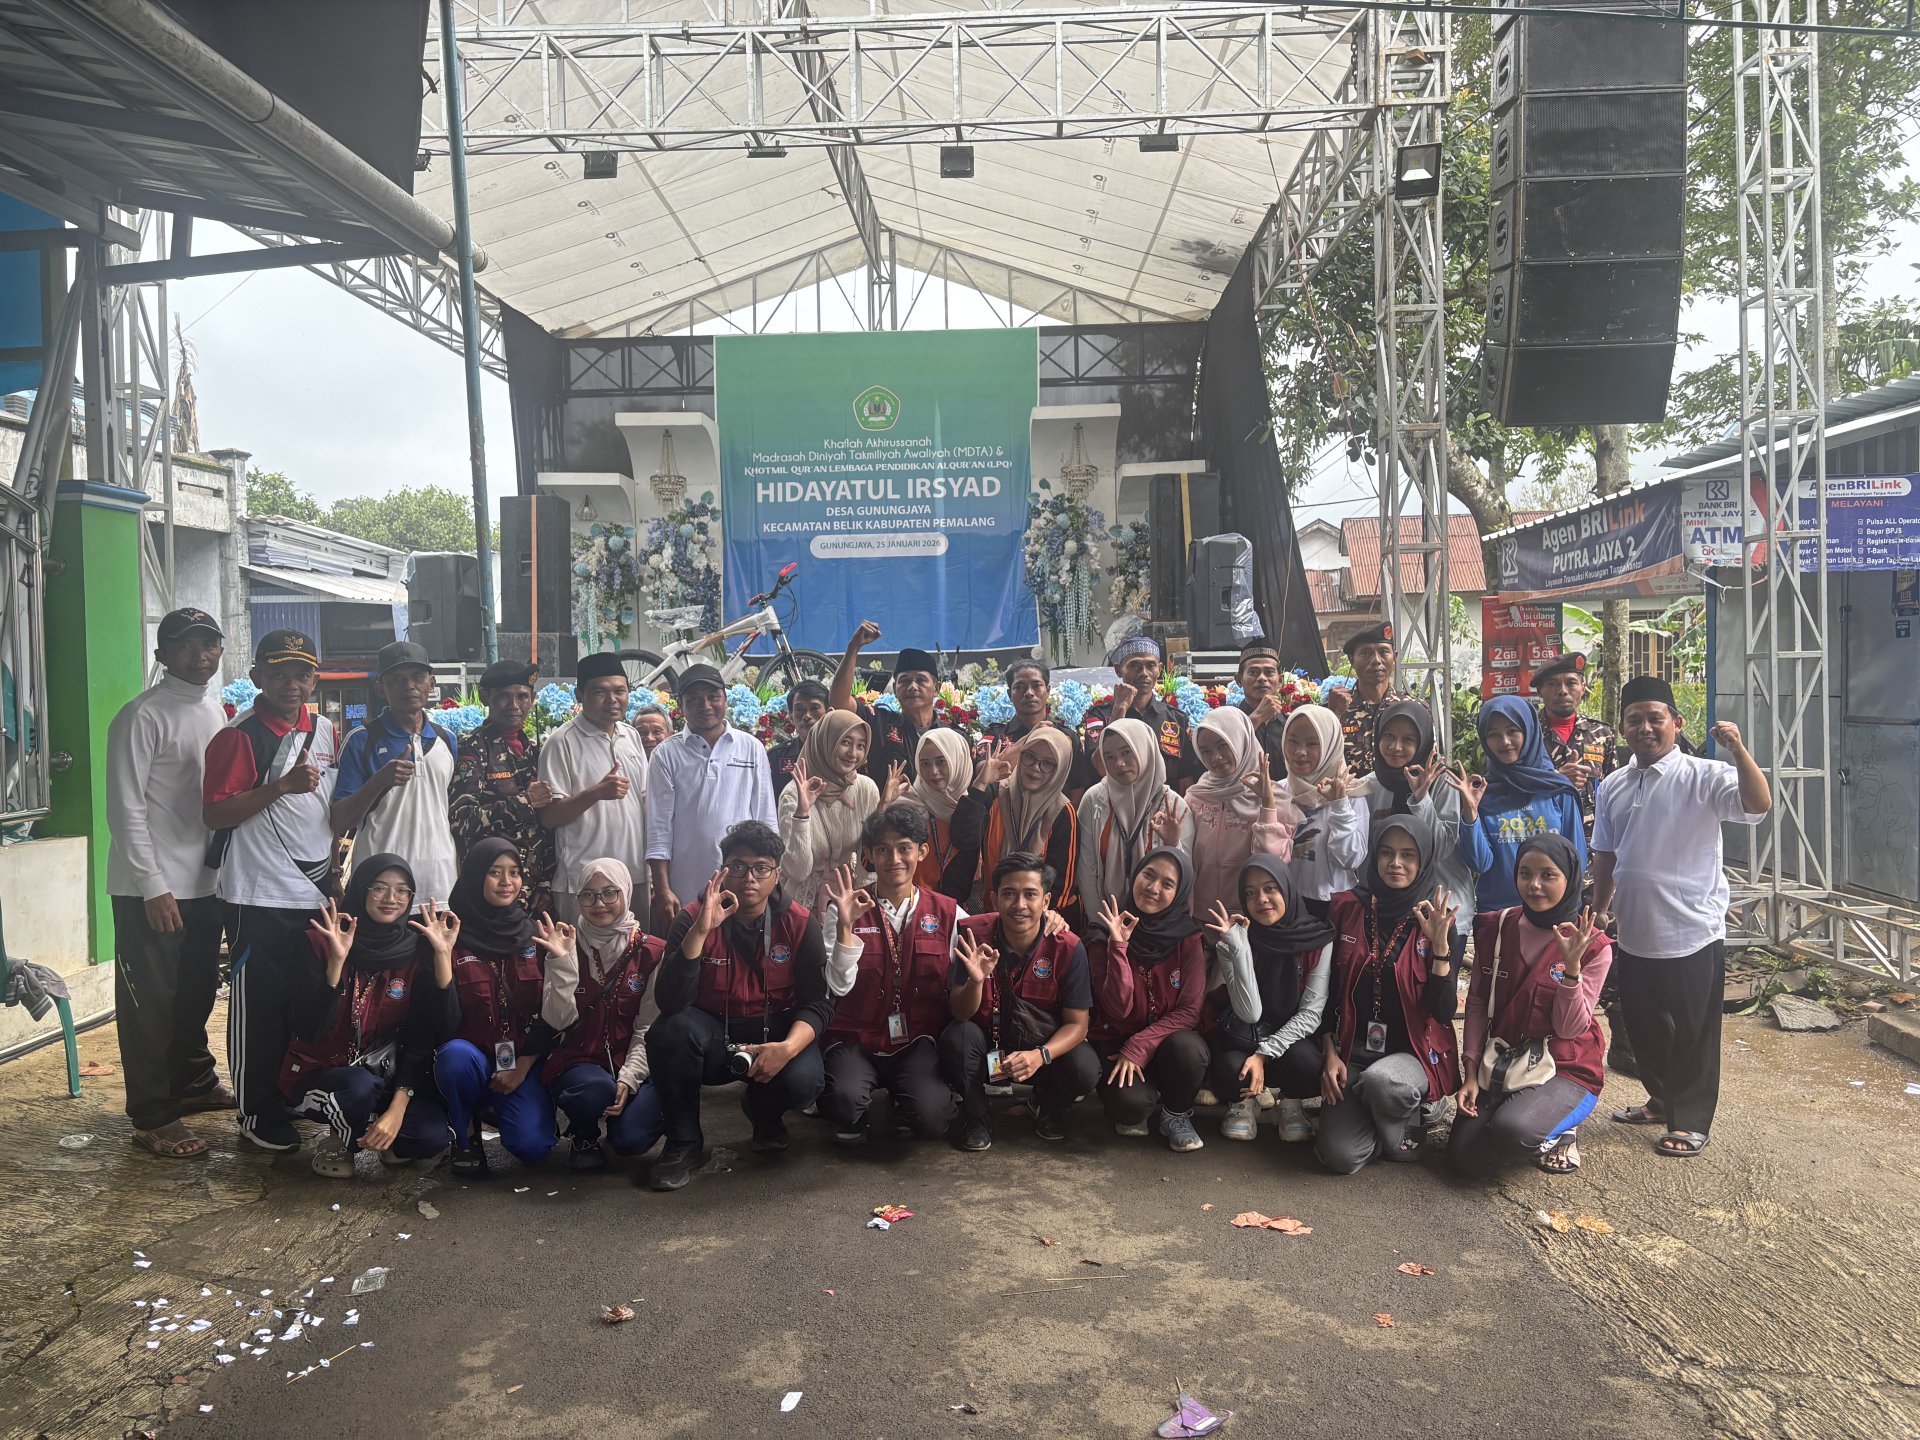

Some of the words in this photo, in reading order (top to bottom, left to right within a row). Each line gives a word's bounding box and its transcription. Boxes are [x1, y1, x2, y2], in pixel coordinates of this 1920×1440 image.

[824, 438, 863, 449] Khaflah
[866, 436, 932, 448] Akhirussanah
[753, 452, 806, 463] Madrasah
[809, 450, 847, 462] Diniyah
[850, 448, 901, 461] Takmiliyah
[904, 447, 951, 460] Awaliyah
[953, 446, 993, 458] (MDTA)
[996, 446, 1004, 457] &
[744, 466, 789, 477] KHOTMIL
[829, 464, 873, 473] LEMBAGA
[876, 462, 935, 471] PENDIDIKAN
[986, 460, 1013, 469] (LPQ)
[757, 479, 901, 503] HIDAYATUL
[907, 476, 1002, 499] IRSYAD
[826, 506, 854, 516] DESA
[856, 504, 932, 515] GUNUNGJAYA
[1831, 500, 1884, 508] MELAYANI
[763, 521, 831, 533] KECAMATAN
[833, 520, 863, 531] BELIK
[865, 518, 930, 530] KABUPATEN
[933, 517, 995, 528] PEMALANG
[1542, 523, 1577, 553] Agen
[1580, 498, 1646, 539] BRILink
[1690, 526, 1743, 545] ATM
[1867, 528, 1885, 536] Bayar
[820, 541, 875, 550] GUNUNGJAYA,
[876, 540, 886, 549] 25
[887, 540, 921, 549] JANUARI
[922, 539, 941, 548] 2026
[1834, 546, 1852, 554] Motor
[1867, 547, 1888, 555] T-Bank
[1552, 546, 1590, 574] PUTRA
[1592, 539, 1625, 566] JAYA
[1626, 535, 1637, 559] 2
[1867, 557, 1885, 565] Bayar
[1539, 620, 1556, 628] Fisik
[1498, 815, 1547, 832] 2024
